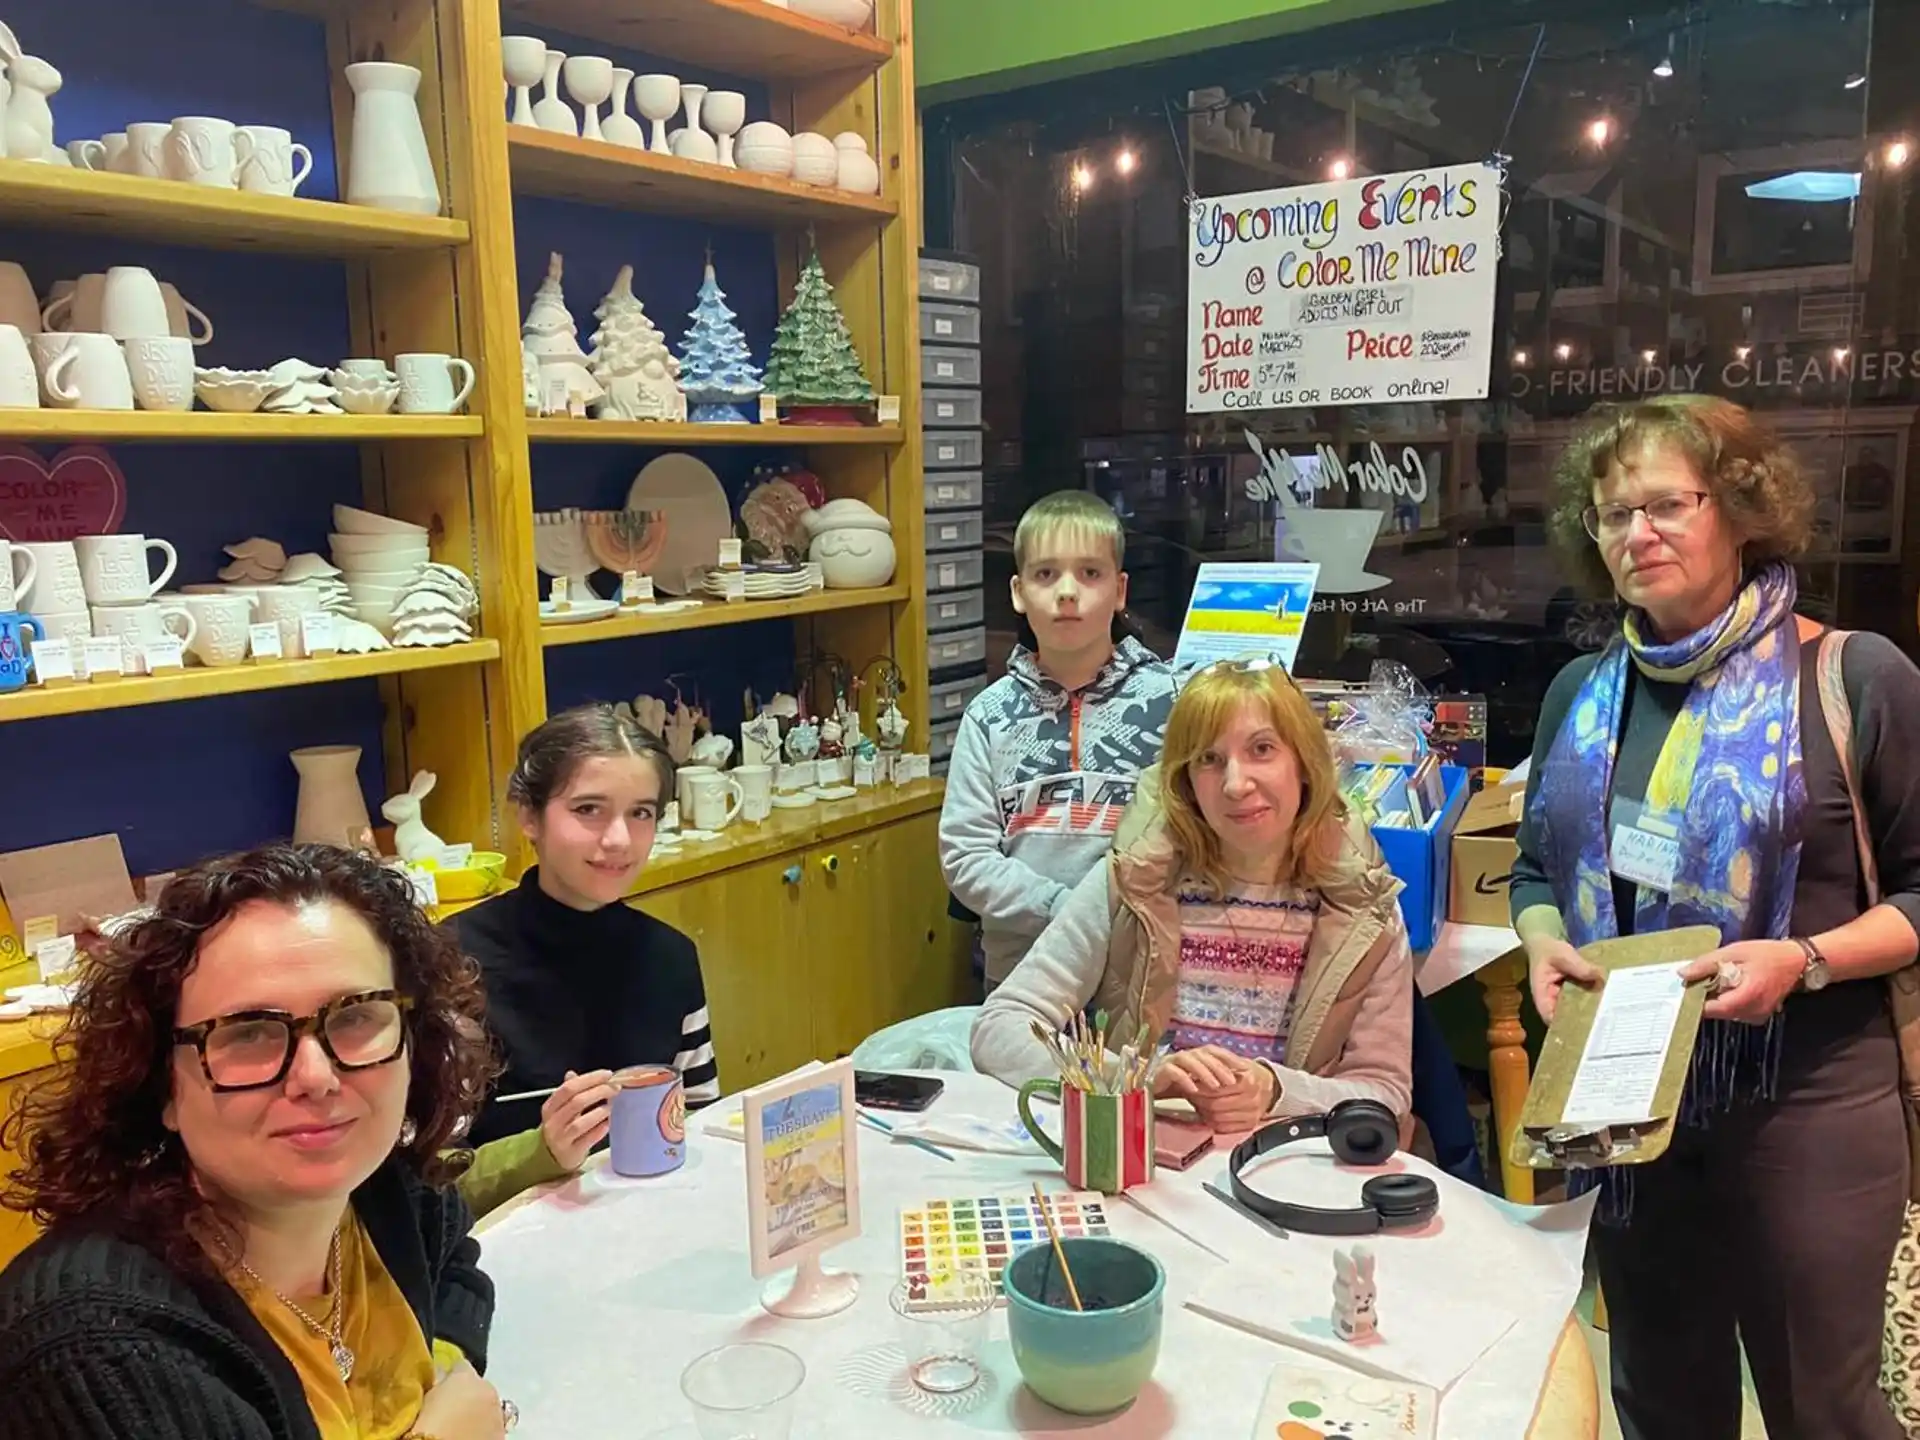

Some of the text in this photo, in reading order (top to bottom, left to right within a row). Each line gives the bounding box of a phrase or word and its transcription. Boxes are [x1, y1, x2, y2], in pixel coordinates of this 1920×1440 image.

[1196, 173, 1477, 267] Upcoming Events
[1245, 266, 1265, 294] @
[1357, 241, 1399, 283] Me
[1404, 236, 1477, 277] Mine
[1309, 292, 1352, 307] GOLDEN
[1343, 301, 1374, 317] NIGHT
[1377, 298, 1404, 315] OUT
[1202, 300, 1263, 330] Name
[1202, 332, 1253, 360] Date
[1198, 361, 1250, 394] Time
[1222, 390, 1262, 408] Call
[1299, 390, 1320, 403] OR
[1331, 386, 1373, 401] BOOK
[36, 503, 77, 520] ME
